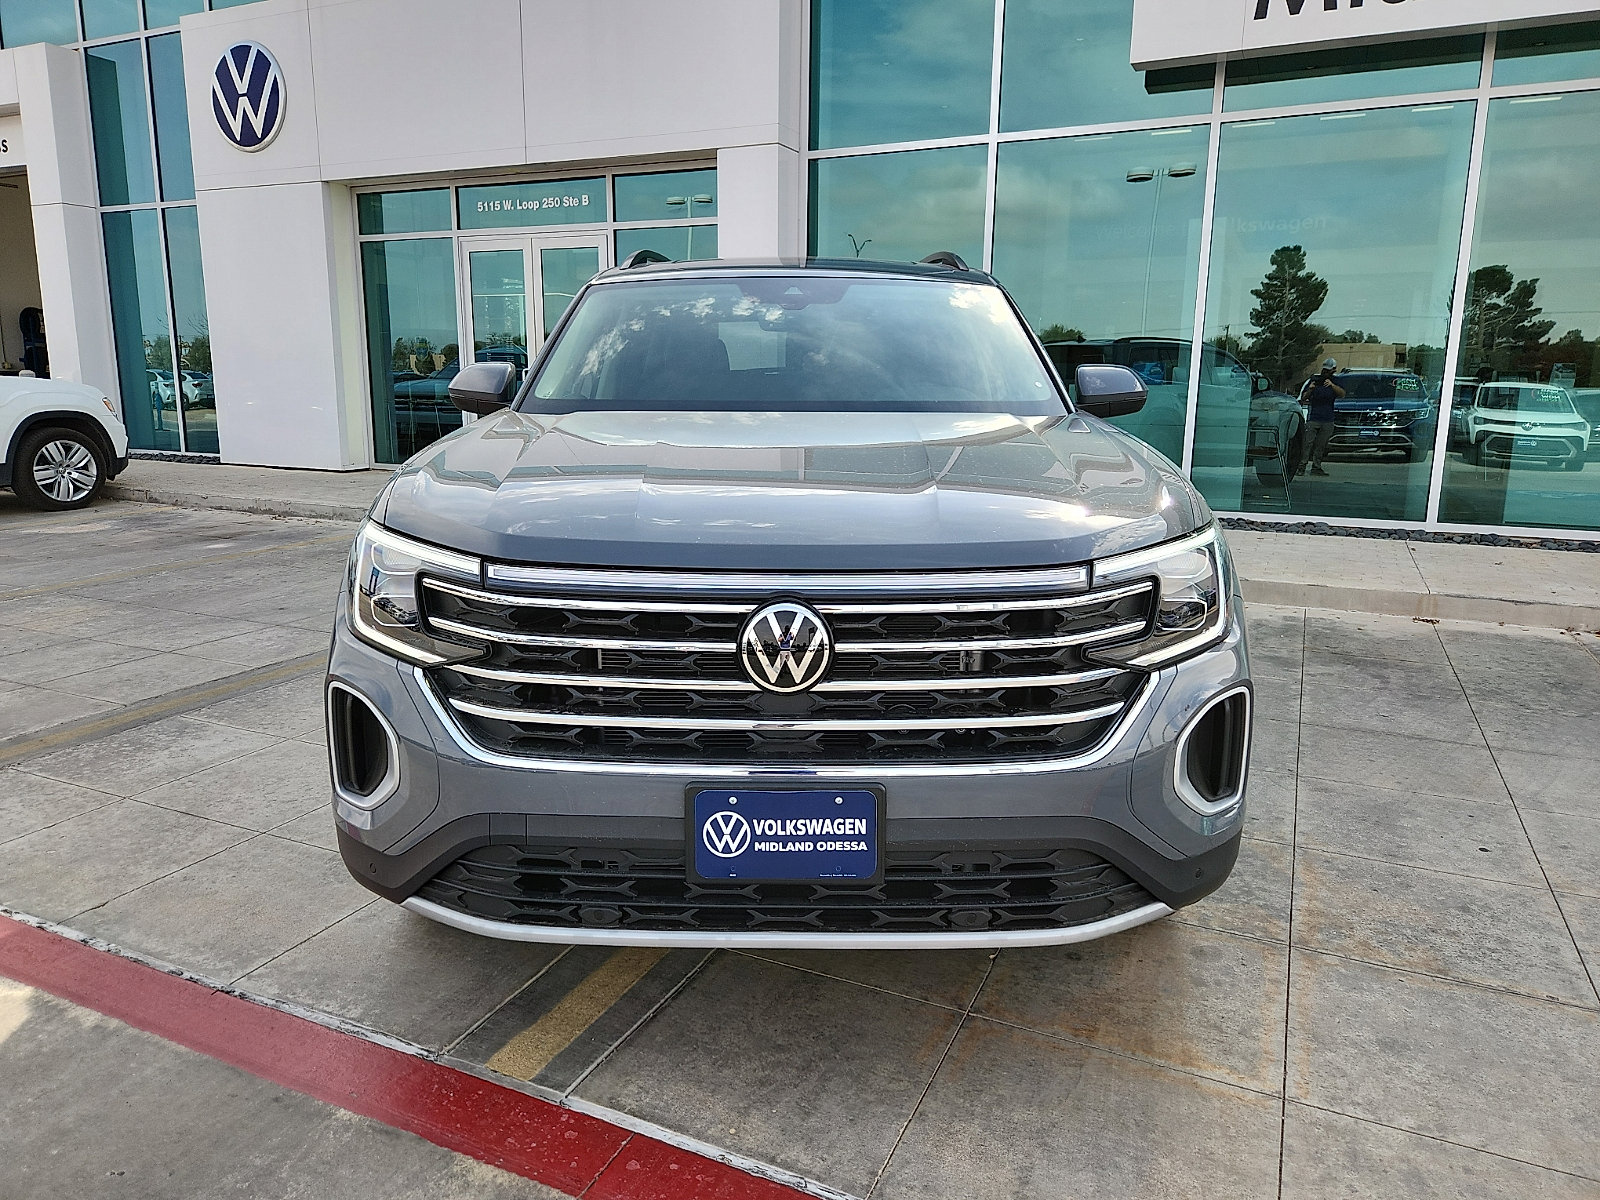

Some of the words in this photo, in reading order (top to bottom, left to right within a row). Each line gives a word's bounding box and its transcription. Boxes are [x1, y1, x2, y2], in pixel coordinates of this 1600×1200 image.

[477, 201, 501, 212] 5115
[503, 199, 514, 210] W.
[517, 199, 540, 211] Loop
[542, 197, 561, 209] 250
[563, 195, 580, 207] Ste
[581, 194, 590, 206] B
[752, 818, 867, 836] VOLKSWAGEN
[754, 841, 814, 852] MIDLAND
[816, 840, 868, 852] ODESSA
